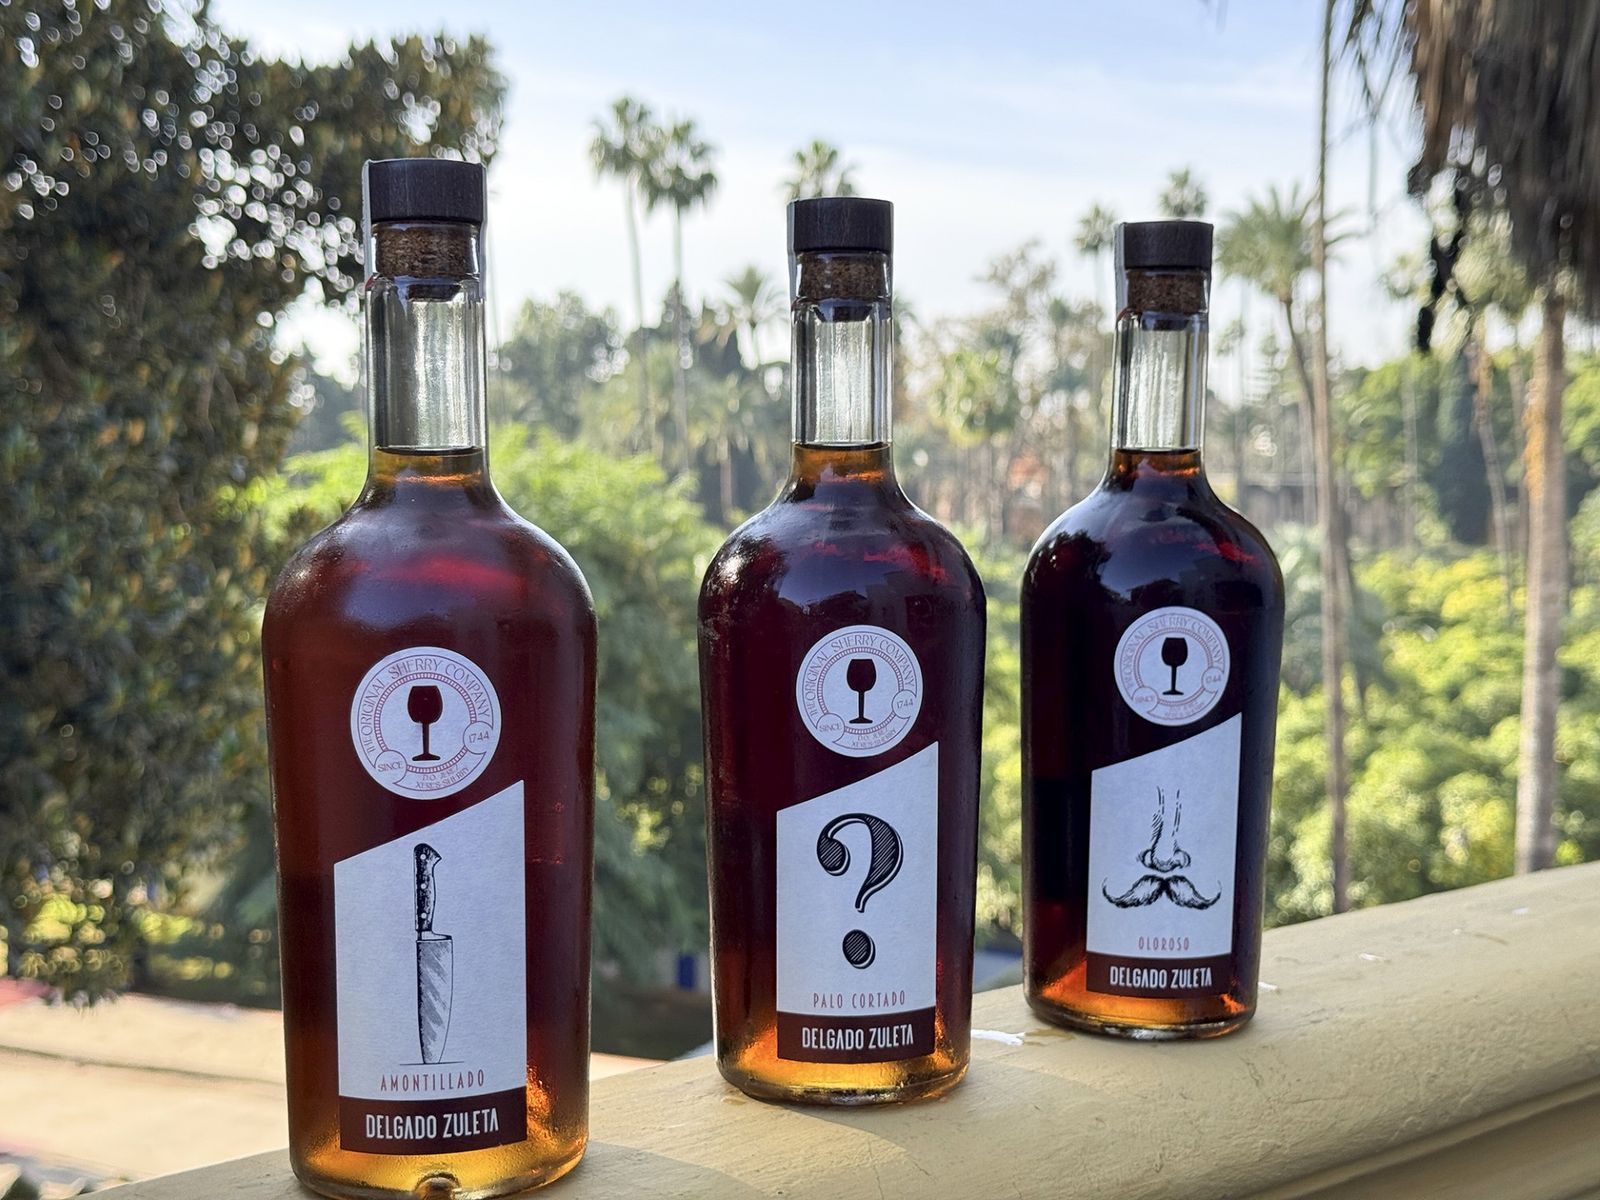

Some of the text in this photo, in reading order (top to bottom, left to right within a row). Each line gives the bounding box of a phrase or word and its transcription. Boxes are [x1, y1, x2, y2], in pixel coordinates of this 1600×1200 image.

[805, 651, 830, 701] ORIGINAL
[831, 634, 877, 652] SHERRY
[879, 640, 915, 687] COMPANY
[361, 678, 388, 734] ORIGINAL
[388, 658, 442, 680] SHERRY
[445, 663, 490, 718] COMPANY
[468, 731, 490, 743] 1744
[378, 763, 403, 772] SINCE
[1138, 936, 1190, 951] OLOROSO
[1109, 965, 1212, 989] DELGADO ZULETA
[813, 990, 906, 1009] PALO CORTADO
[802, 1023, 914, 1050] DELGADO ZULETA
[380, 1069, 485, 1092] AMONTILLADO
[366, 1107, 499, 1140] DELGADO ZULETA
